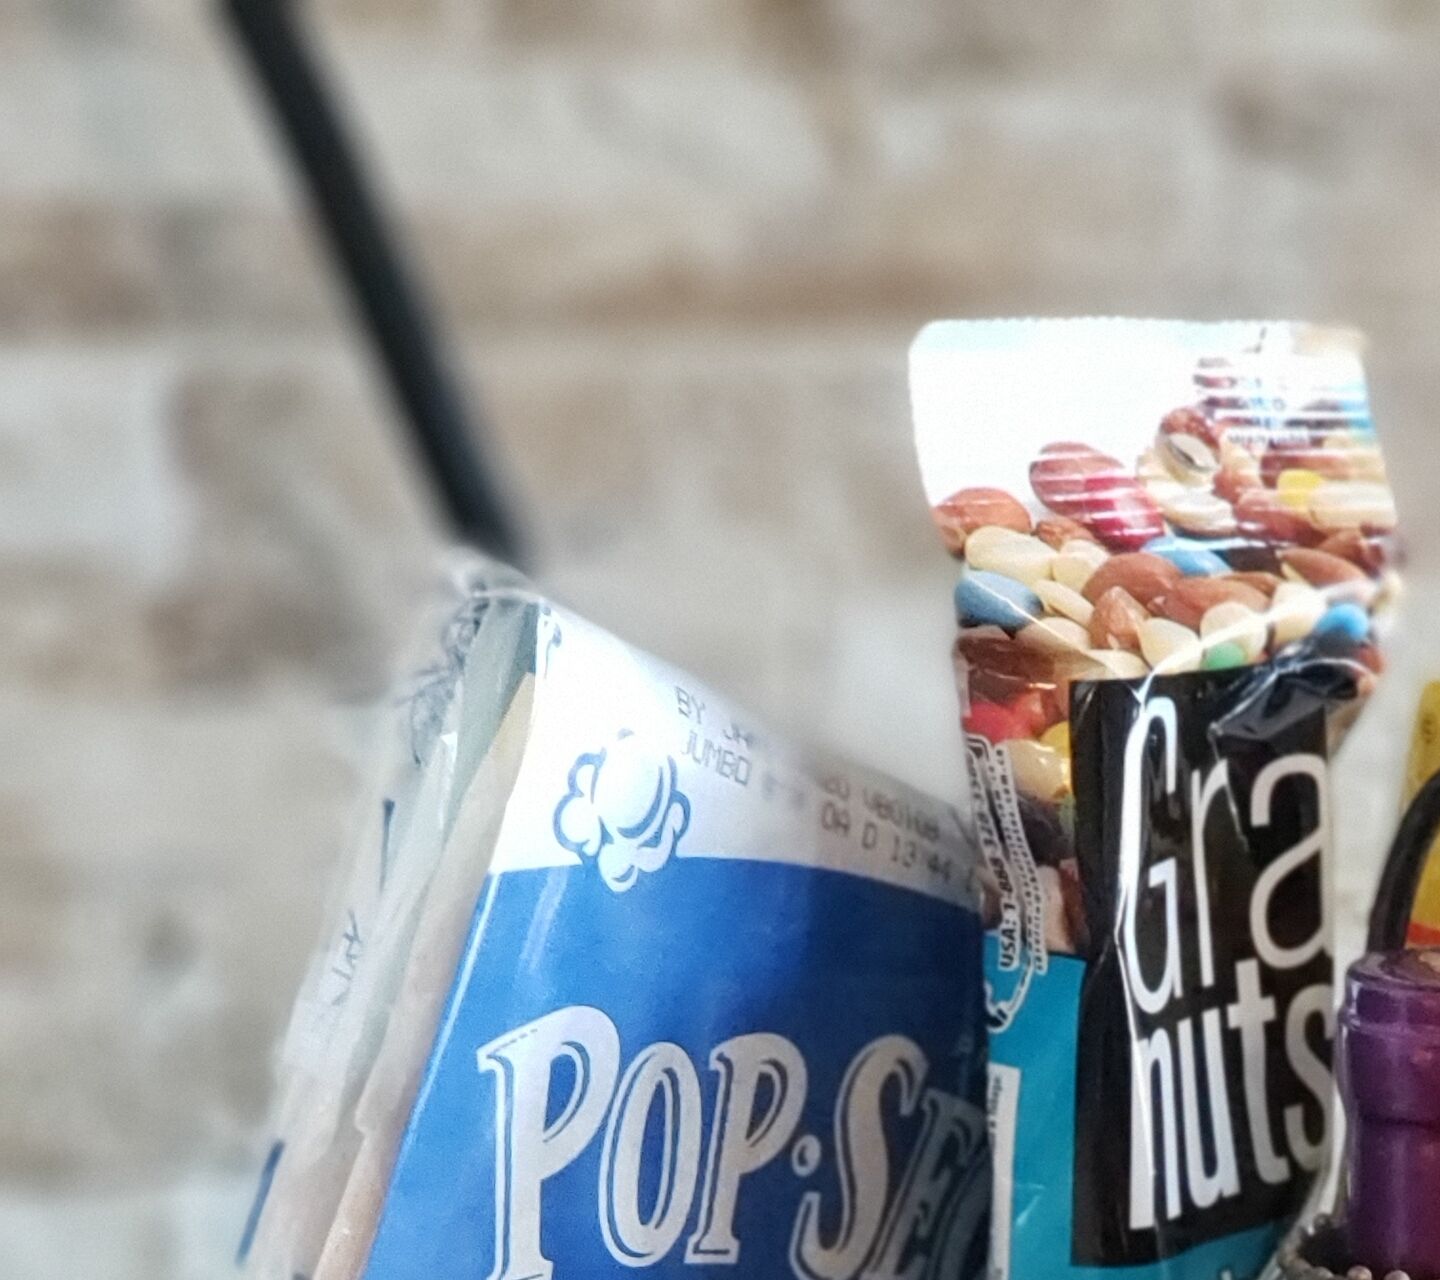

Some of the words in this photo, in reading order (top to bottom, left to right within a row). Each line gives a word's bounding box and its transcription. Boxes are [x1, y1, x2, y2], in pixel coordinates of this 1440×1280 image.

[680, 729, 752, 787] JUMBO
[1115, 695, 1331, 1014] Gra
[1128, 957, 1336, 1231] nuts
